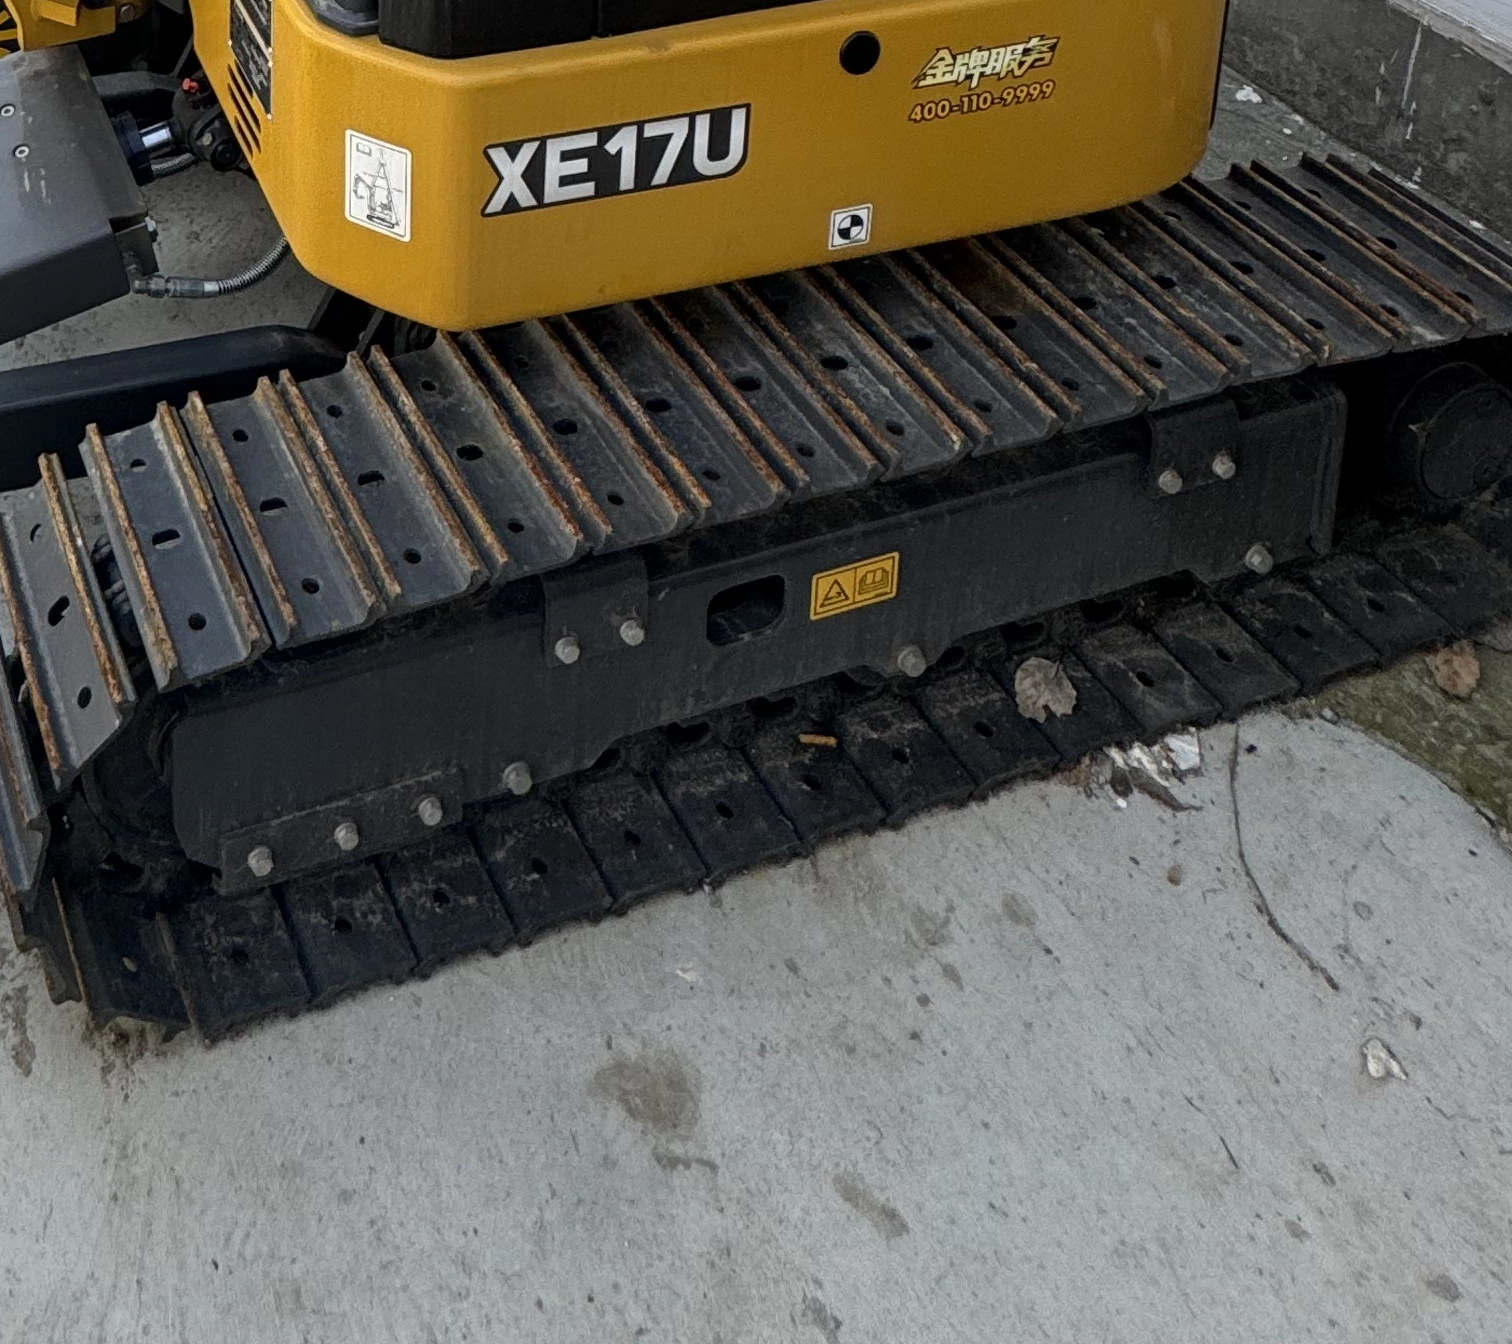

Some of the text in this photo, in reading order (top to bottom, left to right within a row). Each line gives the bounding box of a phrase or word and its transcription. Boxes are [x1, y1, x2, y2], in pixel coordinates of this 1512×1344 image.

[912, 35, 1060, 90] 金牌服务
[908, 80, 1057, 123] 400-110-9999
[484, 105, 749, 216] XE17U
